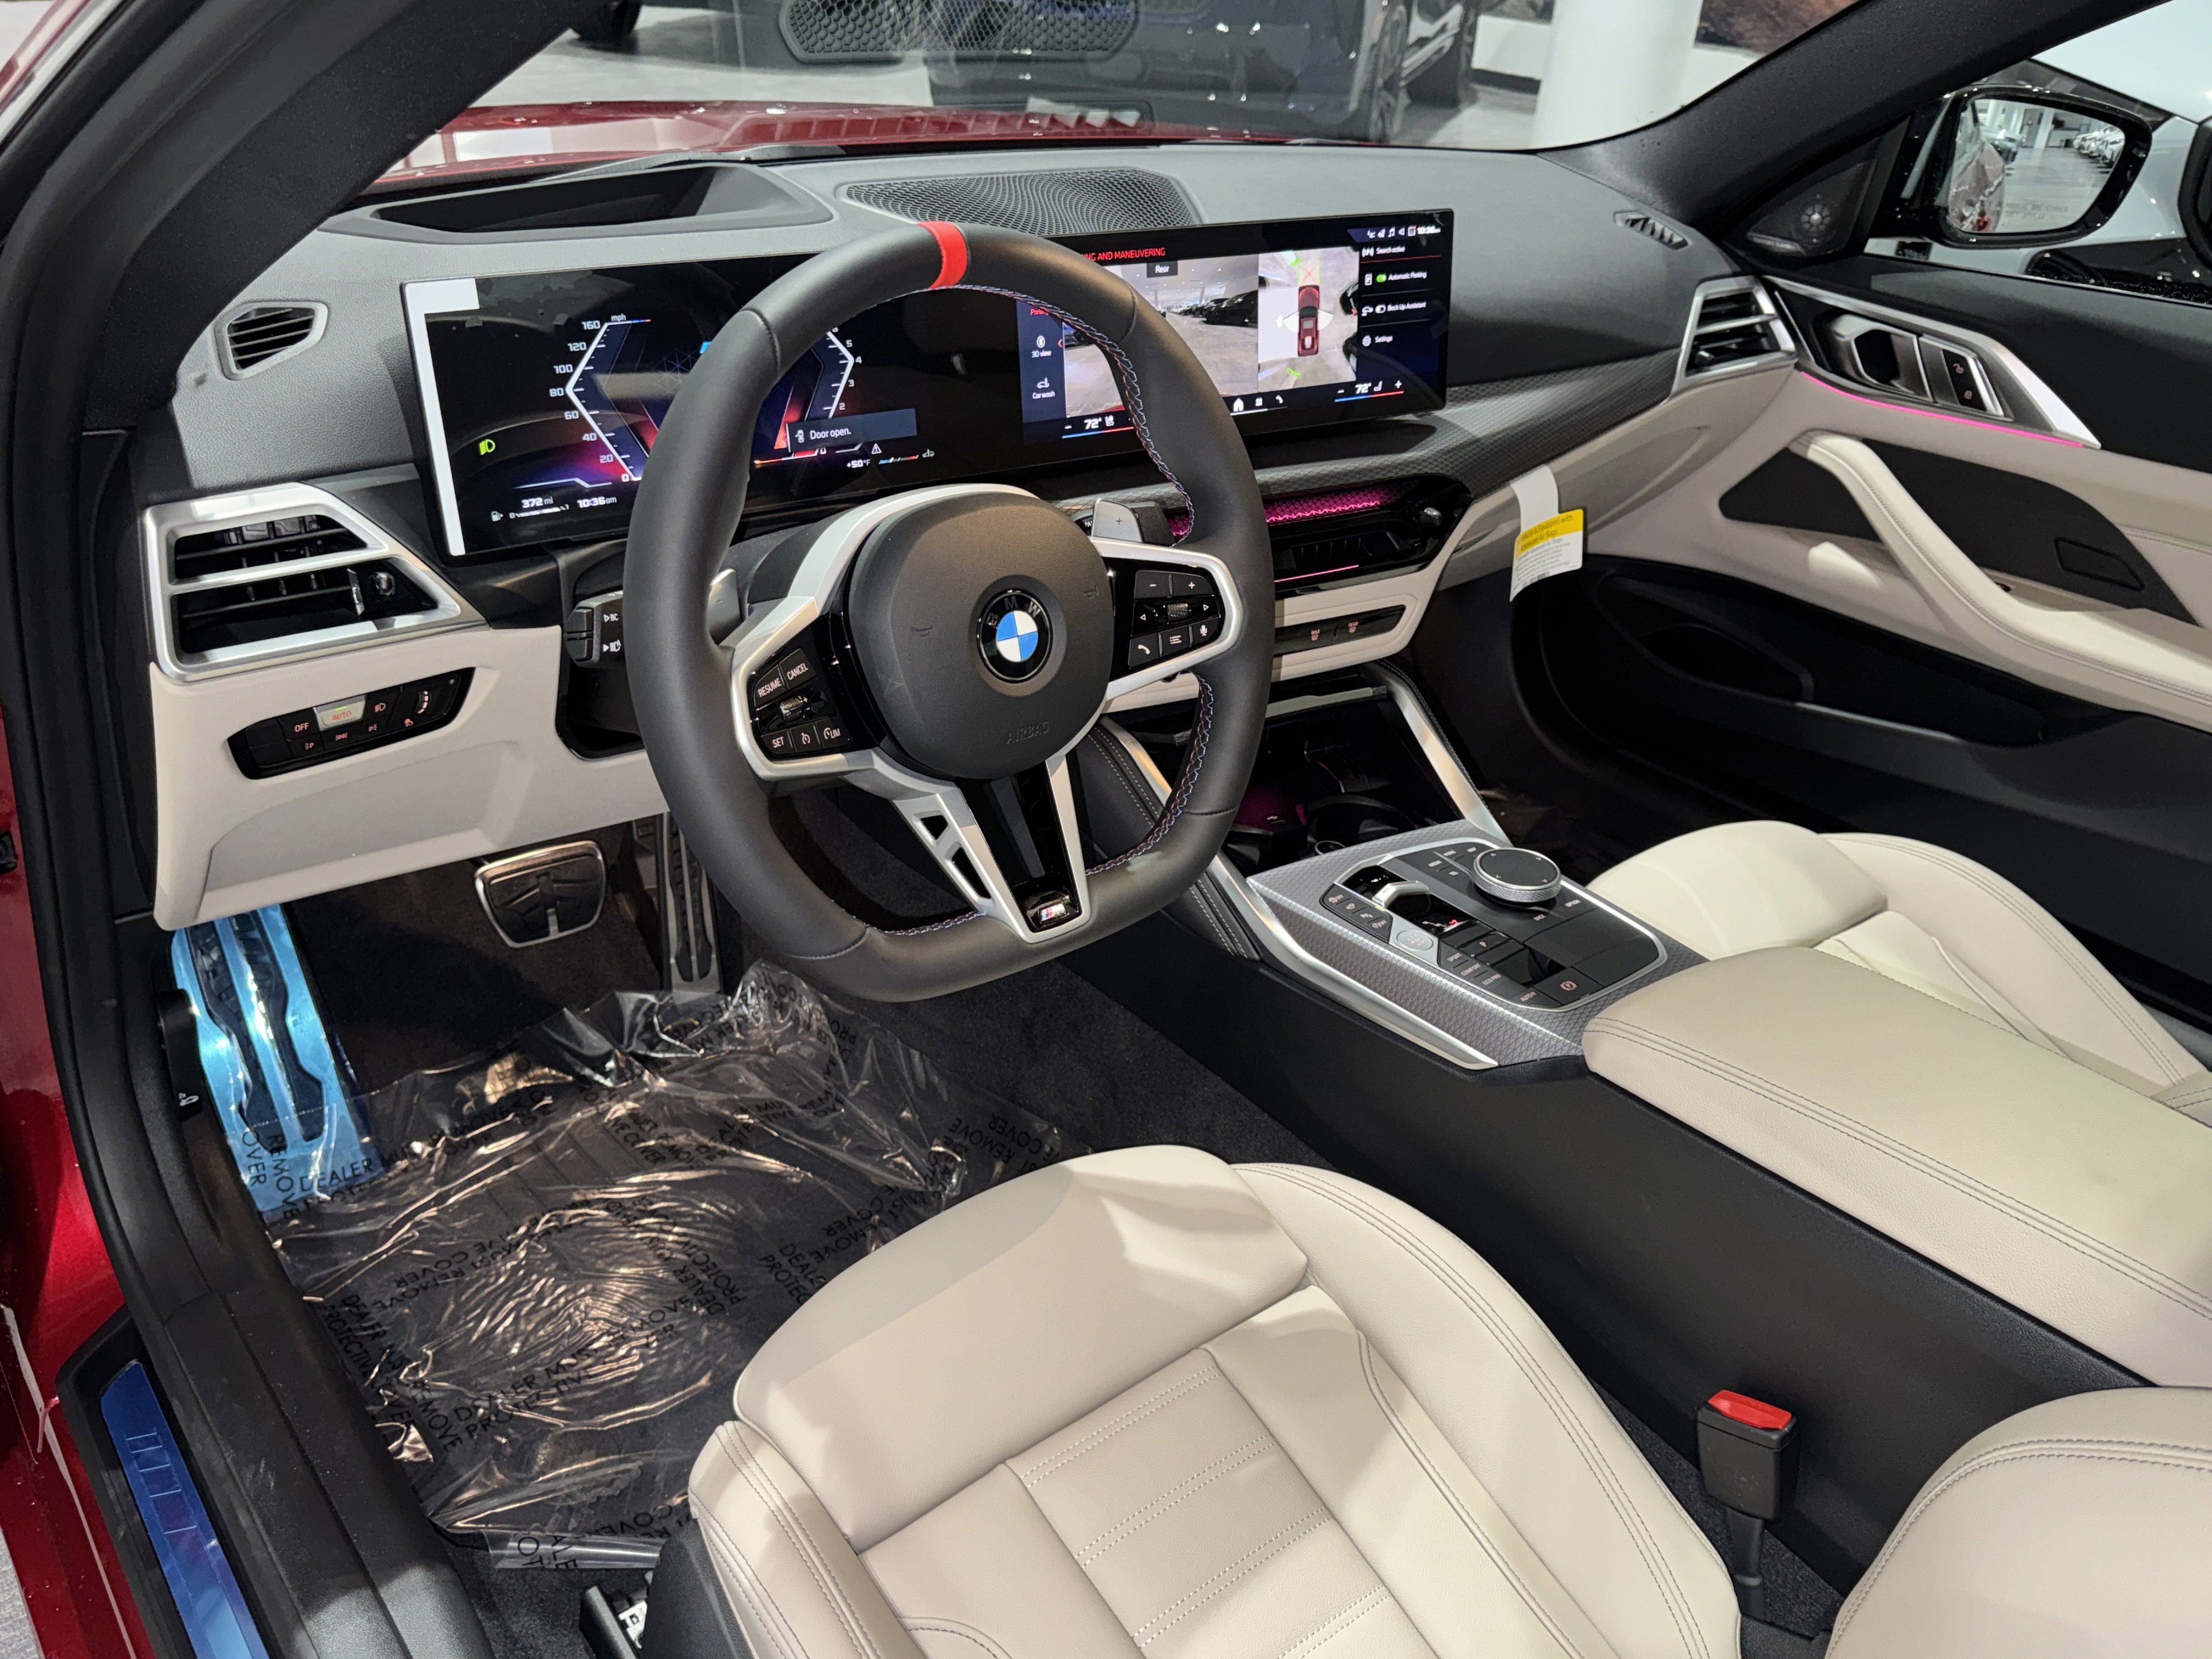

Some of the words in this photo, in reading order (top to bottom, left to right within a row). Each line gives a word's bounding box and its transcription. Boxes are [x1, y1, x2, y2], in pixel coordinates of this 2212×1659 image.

[1097, 251, 1113, 261] AND
[1114, 247, 1166, 259] MANEUVERING
[1155, 264, 1170, 273] Rear
[611, 313, 627, 323] mph
[582, 320, 601, 330] 160
[567, 342, 587, 352] 120
[1040, 349, 1052, 358] view
[855, 356, 862, 364] 4
[553, 364, 574, 374] 100
[848, 379, 855, 387] 3
[549, 387, 565, 397] 80
[839, 402, 845, 410] 2
[564, 410, 579, 420] 60
[582, 432, 597, 442] 40
[810, 430, 829, 440] Door
[830, 428, 851, 438] open.
[600, 454, 614, 464] 20
[621, 473, 629, 482] 0
[521, 497, 543, 509] 372
[544, 496, 554, 505] mi
[610, 613, 619, 622] BC
[988, 596, 1041, 628] BMW
[787, 662, 809, 681] CANCEL
[758, 678, 782, 698] RESUME
[332, 710, 352, 720] AUTO
[294, 722, 309, 732] OFF
[1006, 721, 1050, 744] AIRBAG
[772, 736, 784, 748] SET
[1447, 952, 1462, 962] SPORT
[1460, 963, 1481, 976] COMFORT
[1482, 977, 1493, 986] ECO
[950, 1117, 1012, 1164] REMOVE
[989, 1114, 1041, 1155] COVER
[242, 1131, 267, 1187] OVER
[300, 1158, 373, 1192] DEALER
[824, 1197, 883, 1236] COVER
[393, 1252, 469, 1289] COVER
[679, 1235, 748, 1305] PROTECTIV
[780, 1243, 827, 1290] DEALE
[758, 1254, 812, 1305] PROTEC
[672, 1265, 726, 1314] DEALER
[341, 1293, 387, 1342] DEALER
